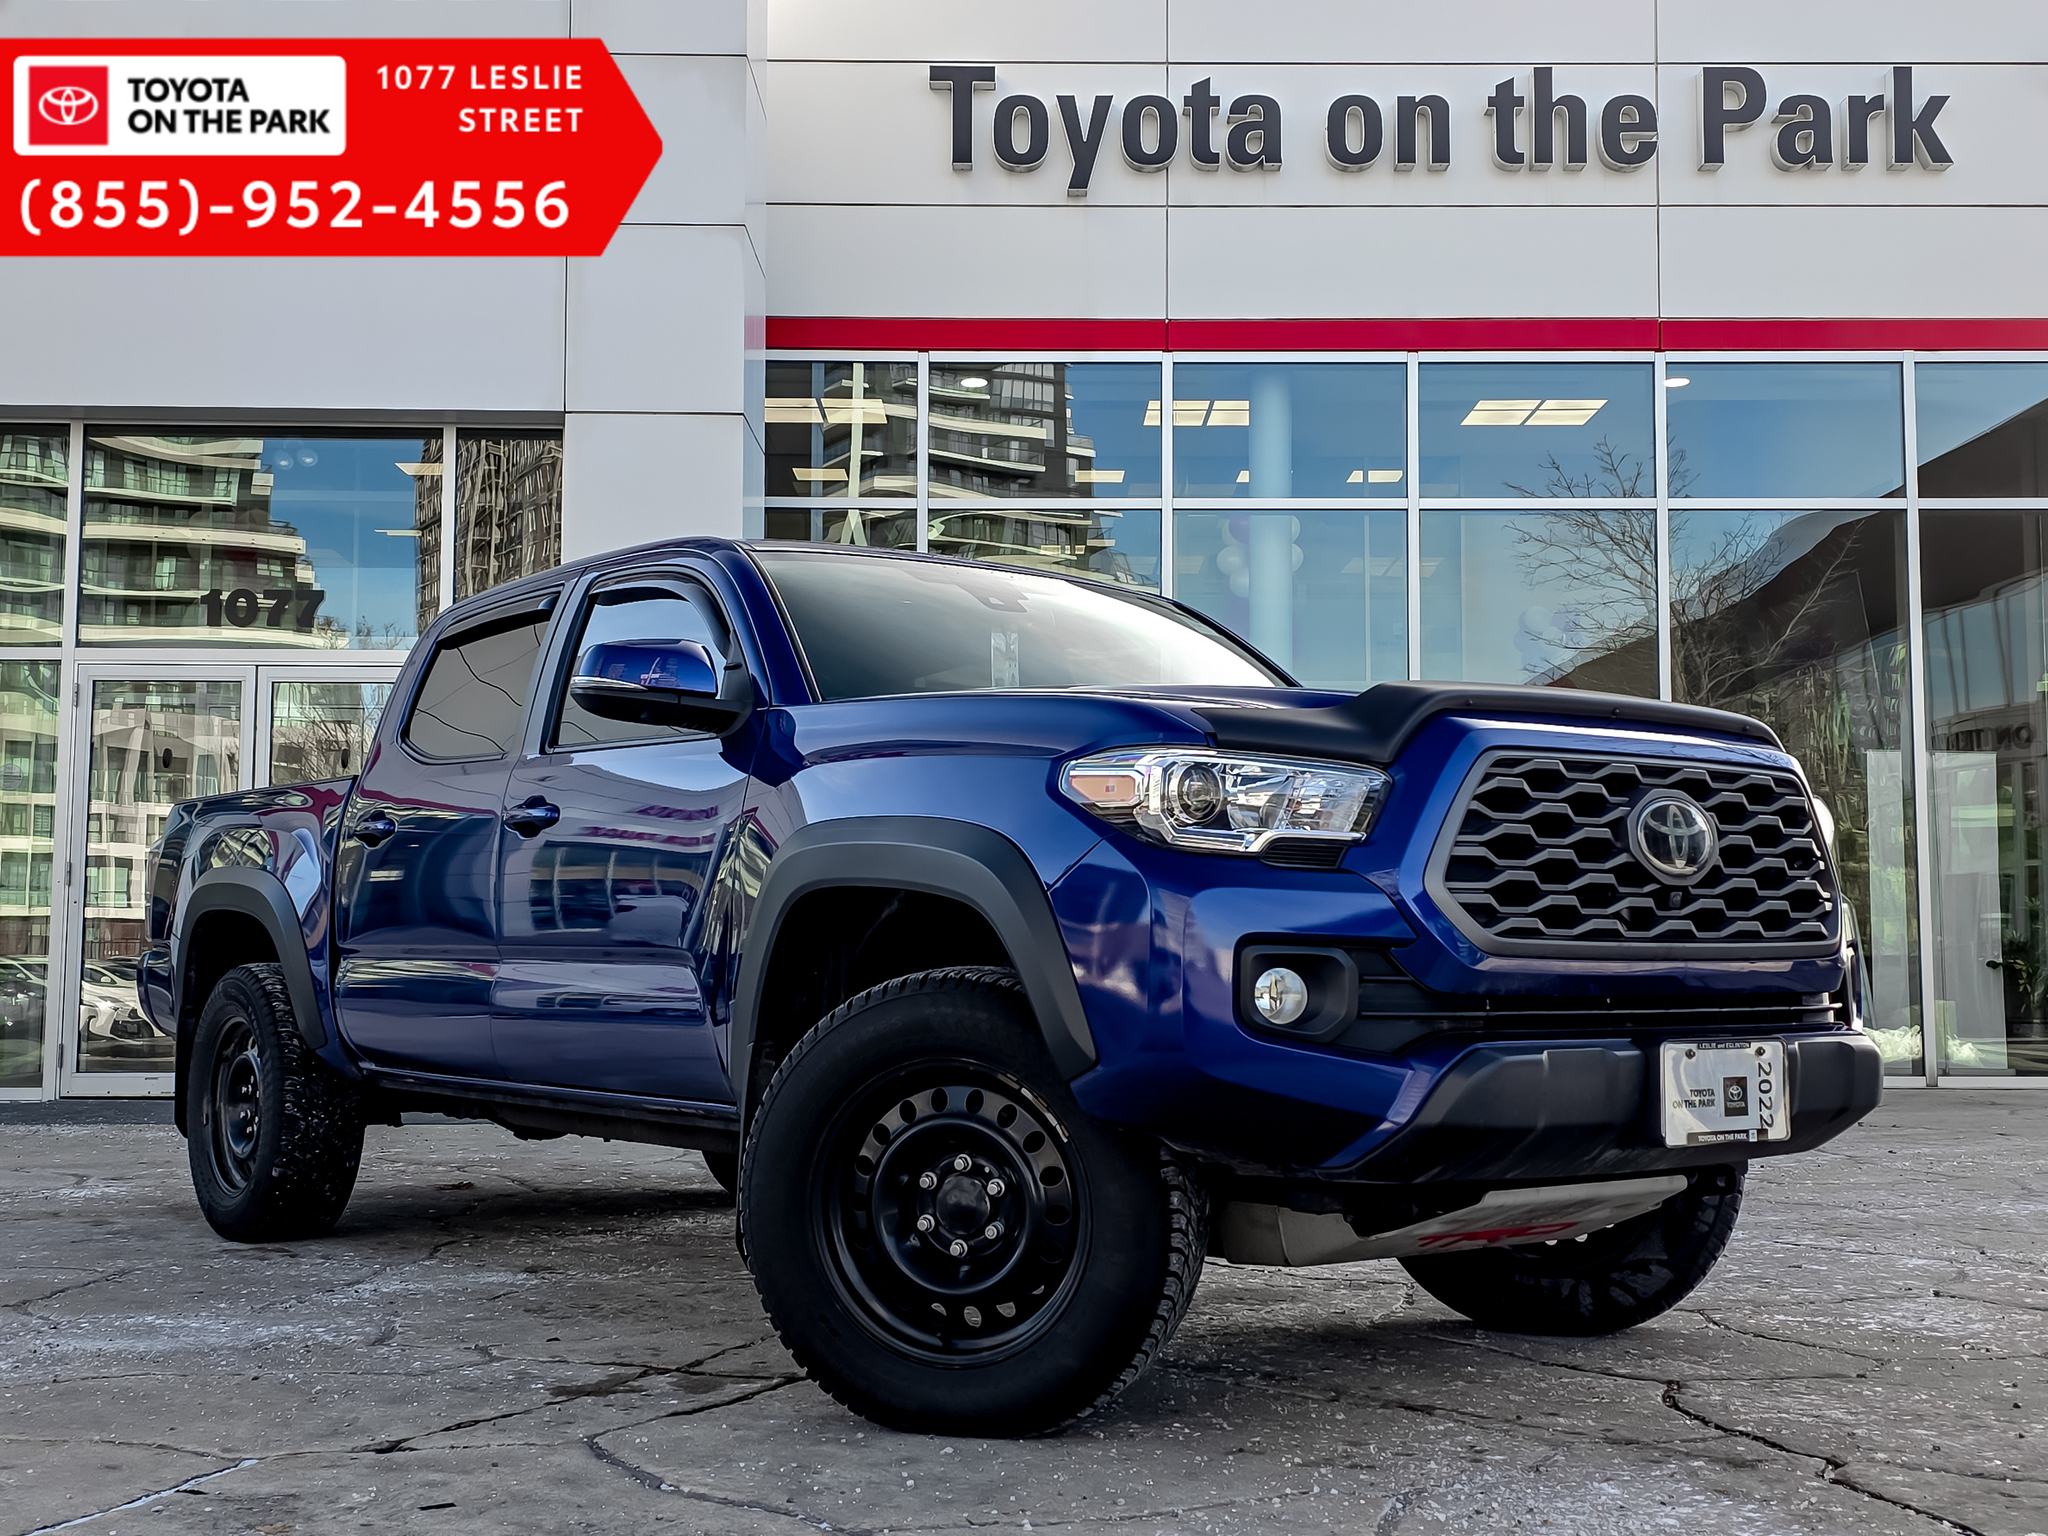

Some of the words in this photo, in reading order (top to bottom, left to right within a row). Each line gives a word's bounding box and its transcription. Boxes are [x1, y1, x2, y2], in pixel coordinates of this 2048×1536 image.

[928, 64, 1283, 197] Toyota
[1325, 92, 1450, 172] on
[1483, 65, 1659, 172] the
[1695, 65, 1953, 172] Park
[200, 588, 325, 628] 1077
[1672, 1100, 1684, 1109] ON
[1684, 1100, 1697, 1108] THE
[1698, 1099, 1715, 1108] PARK
[1689, 1088, 1715, 1098] TOYOTA
[1757, 1061, 1775, 1129] 2022
[1698, 1134, 1716, 1142] TOYOTA
[1716, 1133, 1725, 1141] ON
[1725, 1133, 1734, 1141] THE
[1734, 1132, 1748, 1140] PARK
